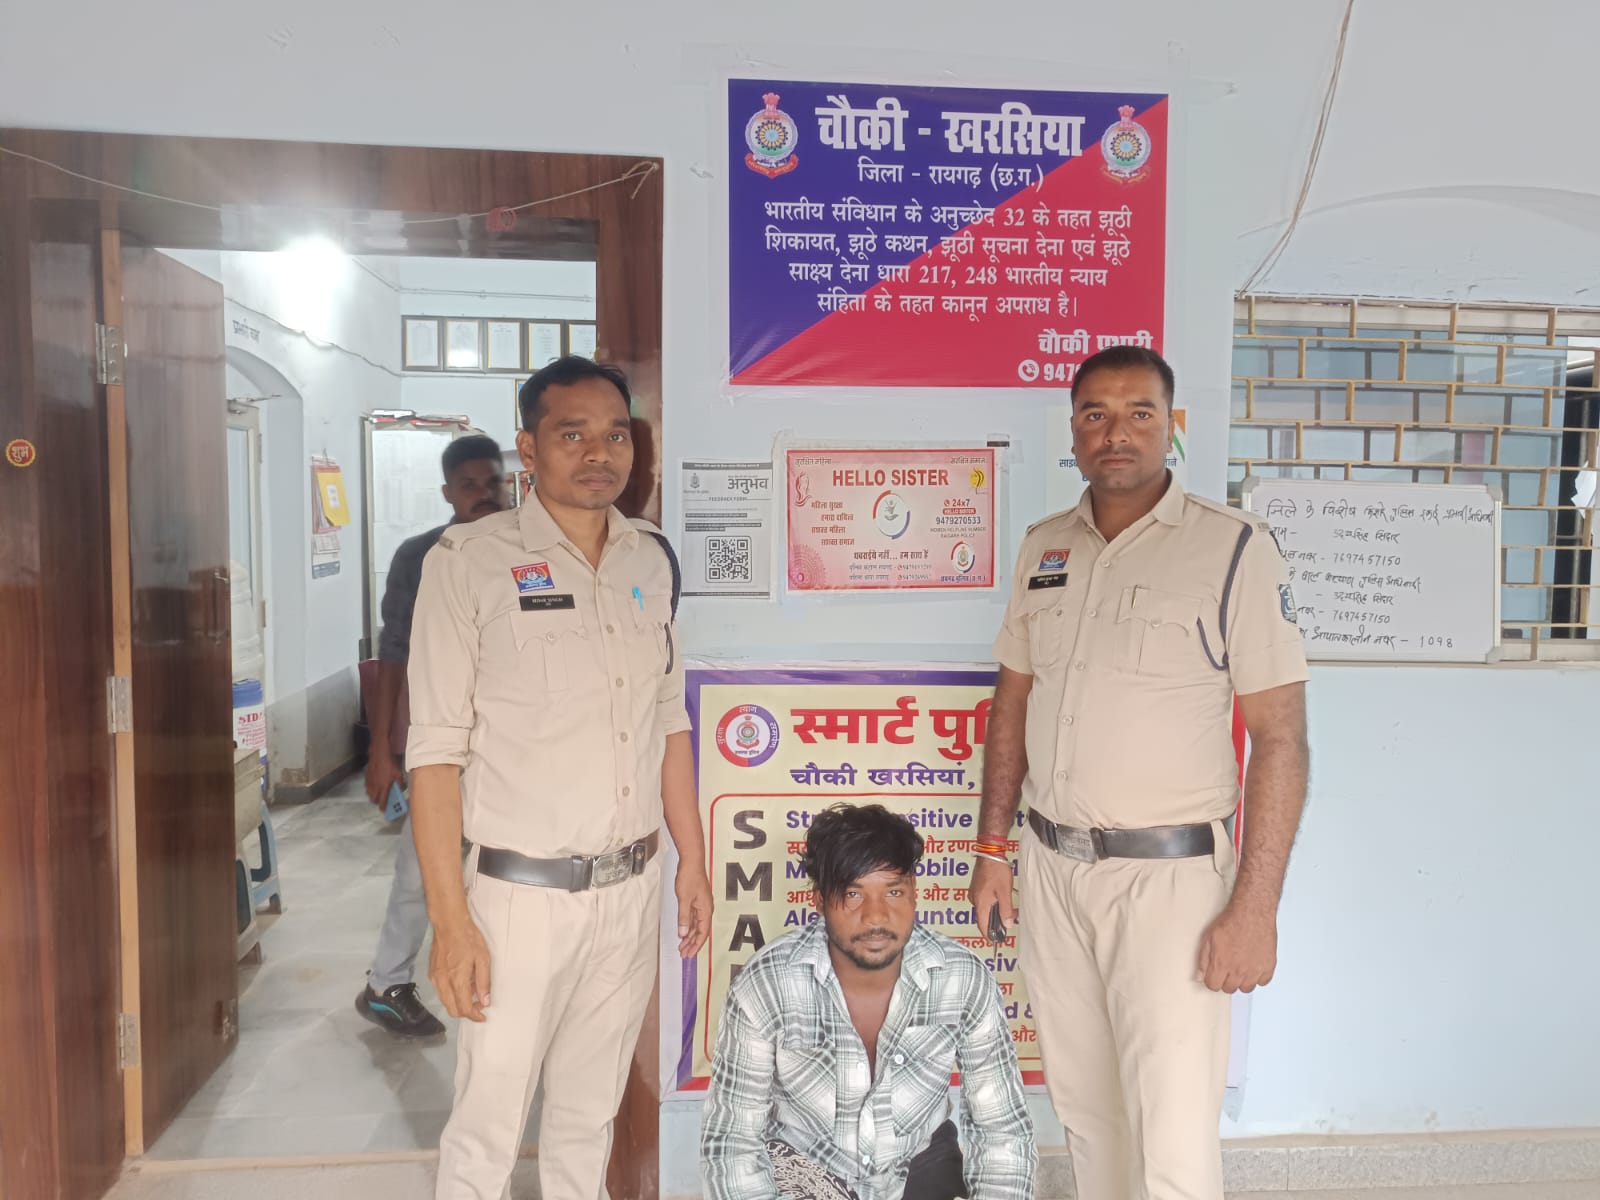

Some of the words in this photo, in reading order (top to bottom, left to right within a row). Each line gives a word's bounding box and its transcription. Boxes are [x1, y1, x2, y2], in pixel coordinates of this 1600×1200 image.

[815, 94, 909, 151] चौकी
[941, 101, 1086, 157] खरसिया
[857, 155, 904, 184] जिला
[929, 166, 982, 189] रायगढ़
[990, 162, 1044, 193] (छ.ग.)
[764, 196, 825, 221] भारतीय
[832, 196, 897, 223] संविधान
[904, 198, 923, 224] के
[930, 200, 996, 231] अनुच्छेद
[1003, 207, 1025, 227] 32
[1032, 202, 1050, 227] के
[1057, 209, 1092, 230] तहत
[1098, 205, 1133, 237] झूठी
[764, 224, 841, 257] शिकायत,
[848, 226, 878, 261] झूठे
[884, 234, 933, 258] कथन,
[940, 230, 975, 263] झूठी
[982, 237, 1029, 263] सूचना
[1035, 231, 1065, 258] देना
[1071, 234, 1095, 262] एवं
[1102, 234, 1132, 266] झूठे
[788, 263, 834, 284] साक्ष्य
[840, 256, 870, 284] देना
[877, 264, 910, 283] धारा
[919, 265, 957, 288] 217,
[965, 266, 998, 285] 248
[1005, 262, 1064, 286] भारतीय
[1069, 268, 1109, 287] न्याय
[816, 285, 867, 314] संहिता
[873, 287, 893, 312] के
[899, 294, 935, 315] तहत
[941, 295, 988, 322] कानून
[995, 297, 1052, 315] अपराध
[1038, 328, 1091, 355] चौकी
[727, 478, 769, 494] अनुभव
[833, 469, 886, 487] HELLO
[891, 469, 949, 487] SISTER
[952, 498, 971, 507] 24x7
[935, 516, 982, 525] 9479270533
[1333, 553, 1401, 566] 7697457150
[1333, 609, 1391, 623] 7697457150
[1420, 635, 1454, 648] 1098
[790, 695, 920, 745] स्मार्ट
[790, 761, 858, 786] चौकी
[733, 810, 767, 851] S
[905, 808, 973, 829] sitive
[914, 857, 969, 880] obile
[724, 862, 774, 902] M
[922, 883, 950, 901] और
[728, 913, 767, 953] A
